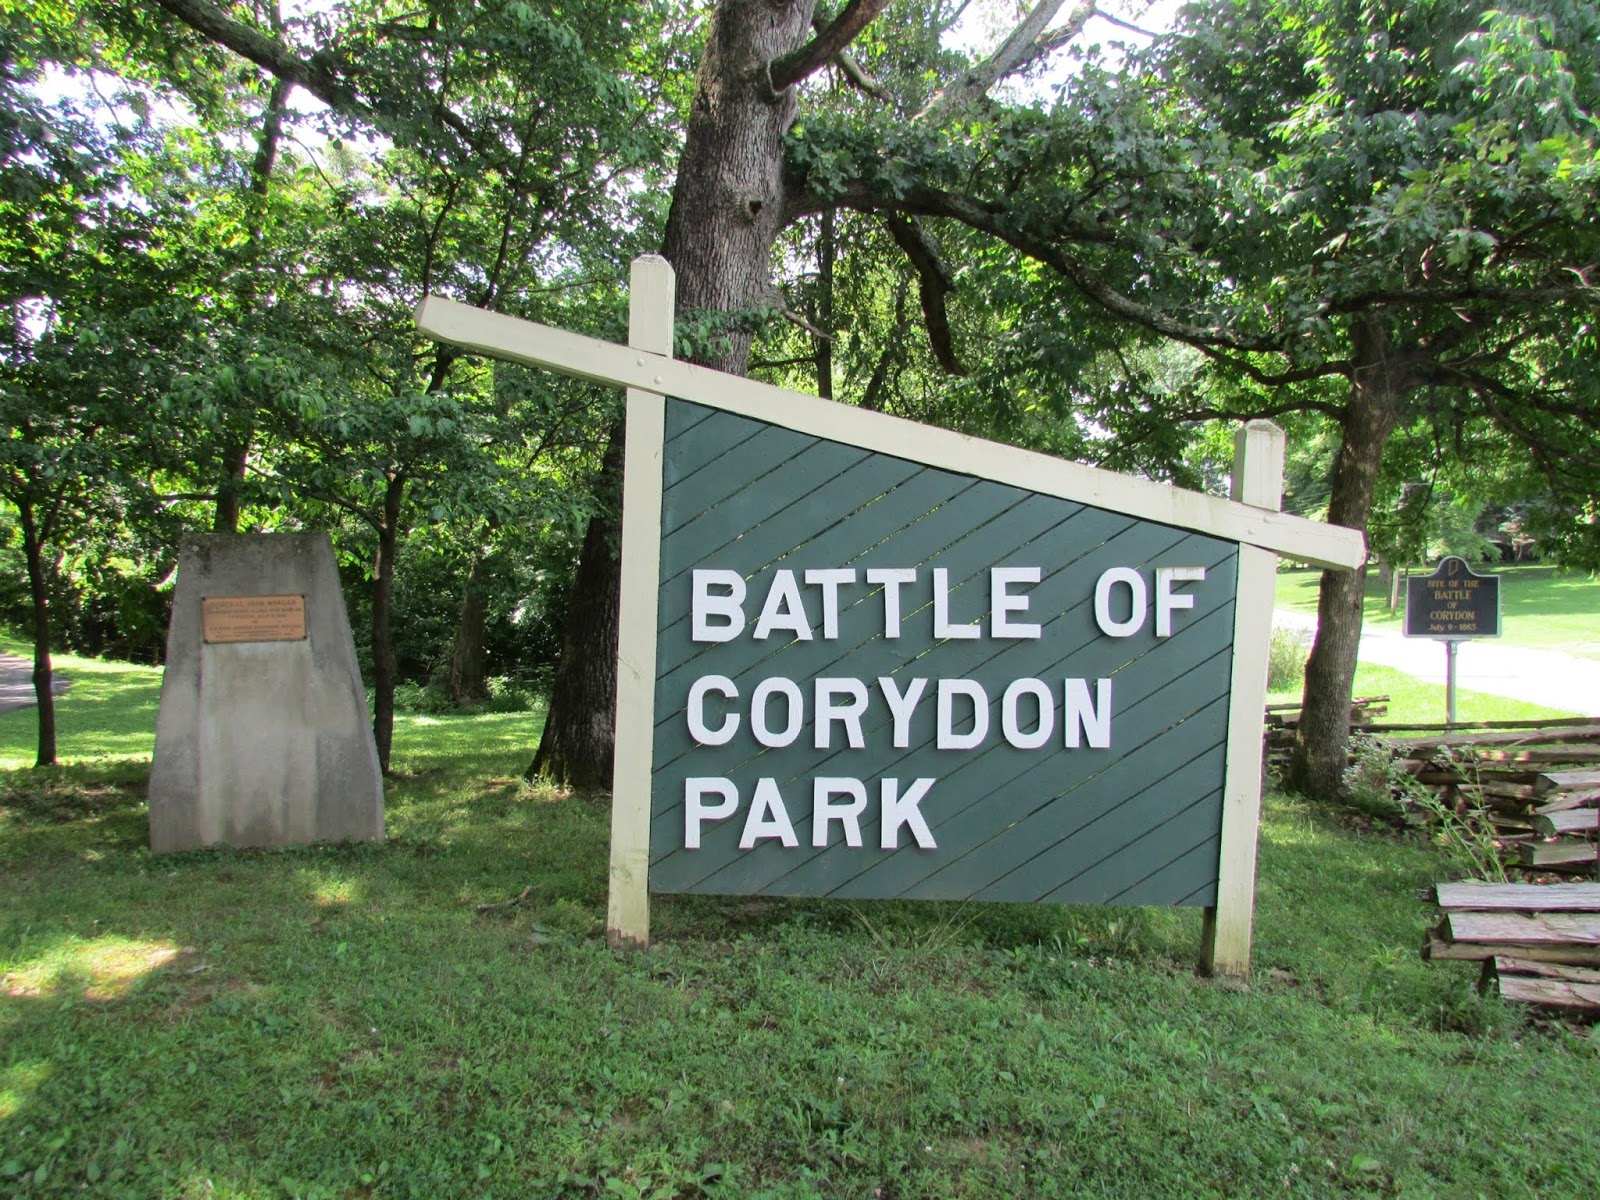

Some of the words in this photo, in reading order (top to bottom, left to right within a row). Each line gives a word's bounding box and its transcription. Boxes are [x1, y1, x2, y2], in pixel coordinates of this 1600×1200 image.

[1427, 580, 1445, 588] SITE
[1448, 580, 1458, 588] OF
[1463, 580, 1480, 588] THE
[1434, 590, 1472, 600] BATTLE
[691, 566, 1042, 643] BATTLE
[1093, 566, 1206, 638] OF
[1430, 611, 1475, 620] CORYDON
[1429, 623, 1445, 632] July
[1447, 623, 1453, 631] 9
[1459, 623, 1477, 631] 1863
[686, 674, 1113, 750] CORYDON
[684, 777, 938, 850] PARK
